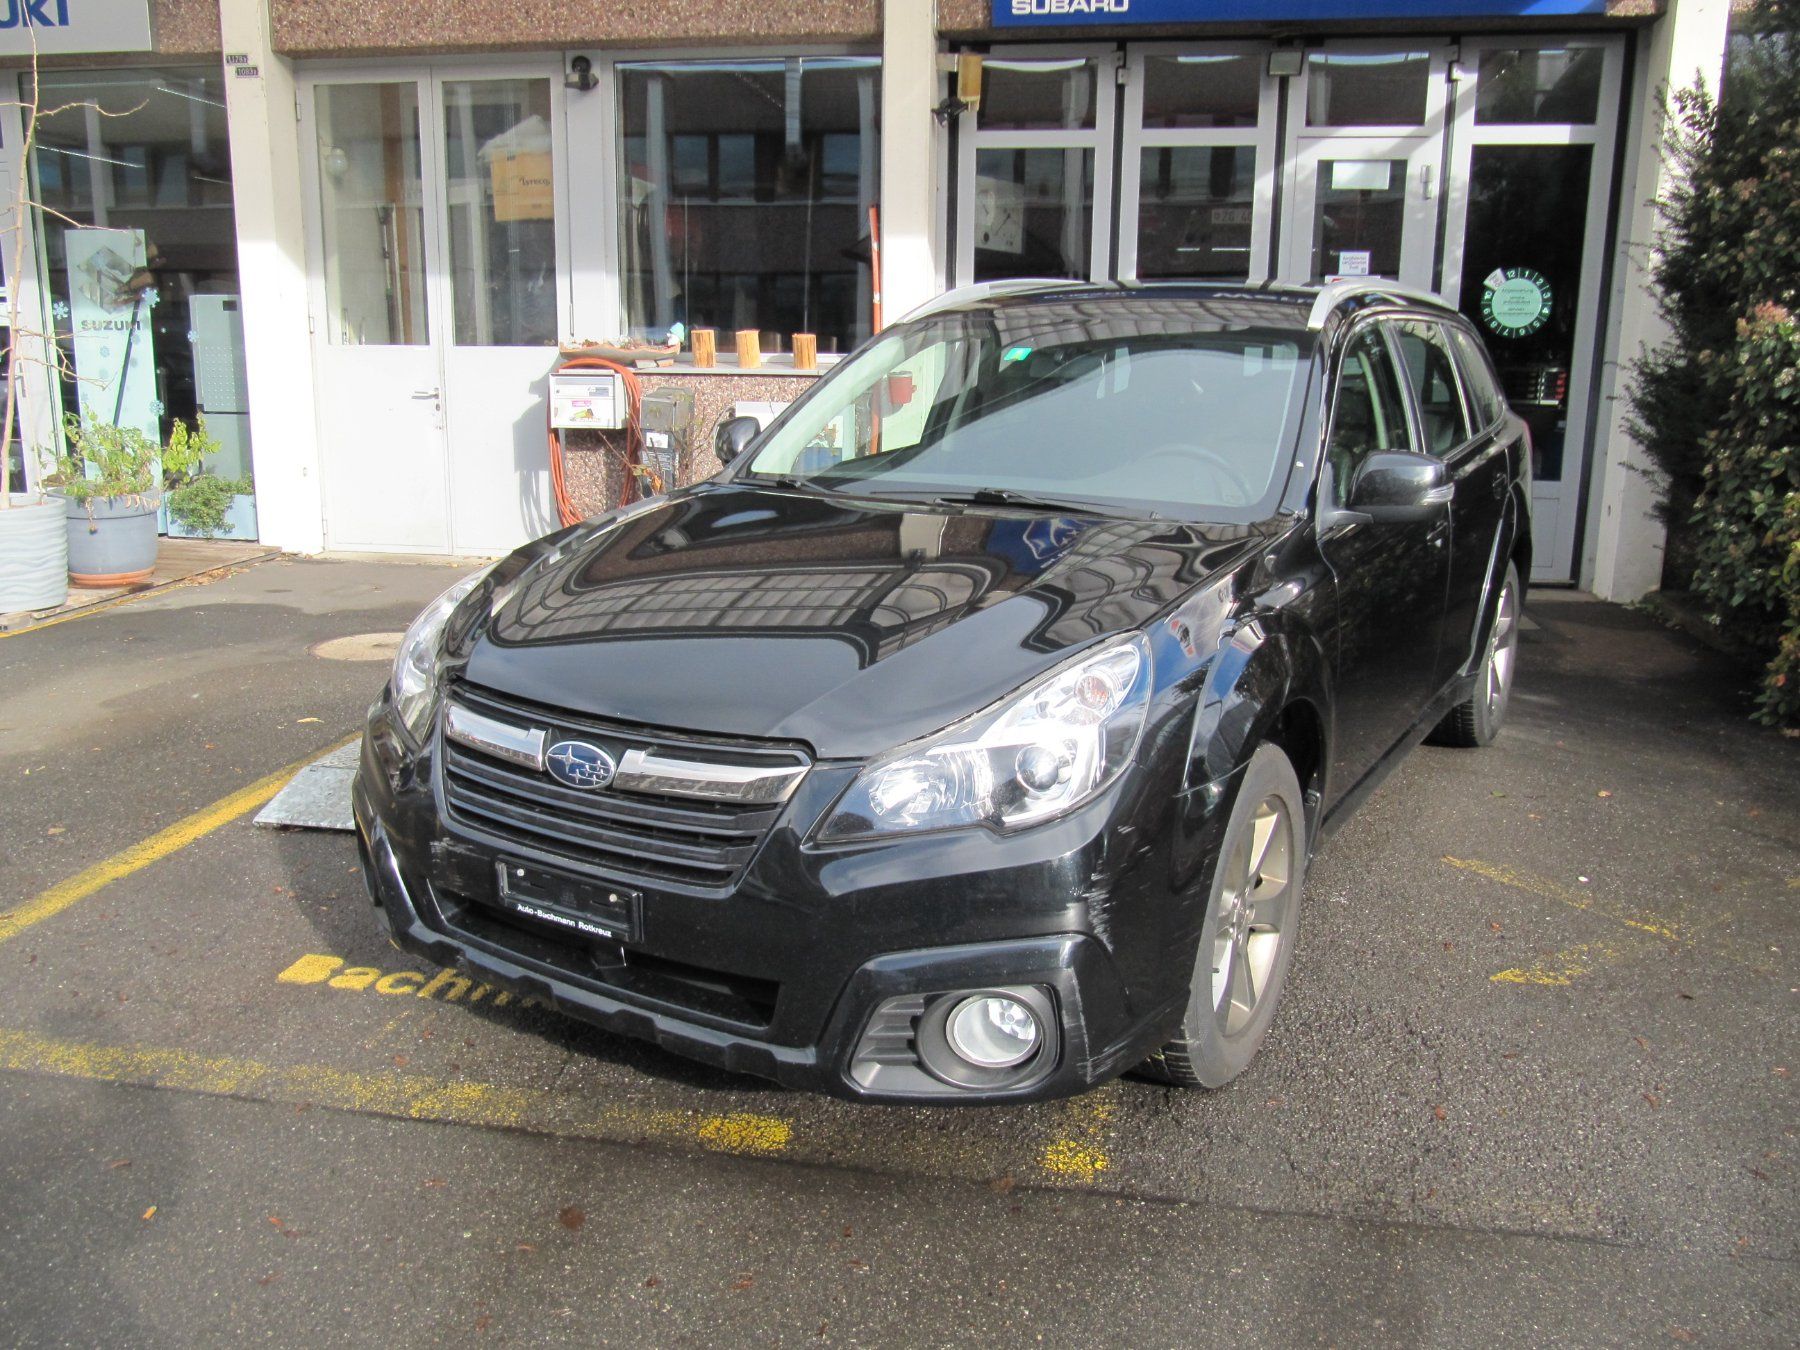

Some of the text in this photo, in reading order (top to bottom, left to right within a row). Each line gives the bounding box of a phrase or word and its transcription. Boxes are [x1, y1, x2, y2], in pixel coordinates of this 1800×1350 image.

[1012, 0, 1129, 15] SUBARU
[1506, 270, 1516, 279] 12
[1525, 270, 1530, 278] 1
[1536, 278, 1544, 286] 2
[81, 319, 141, 331] SUZUKI
[578, 920, 612, 938] Rotkreuz
